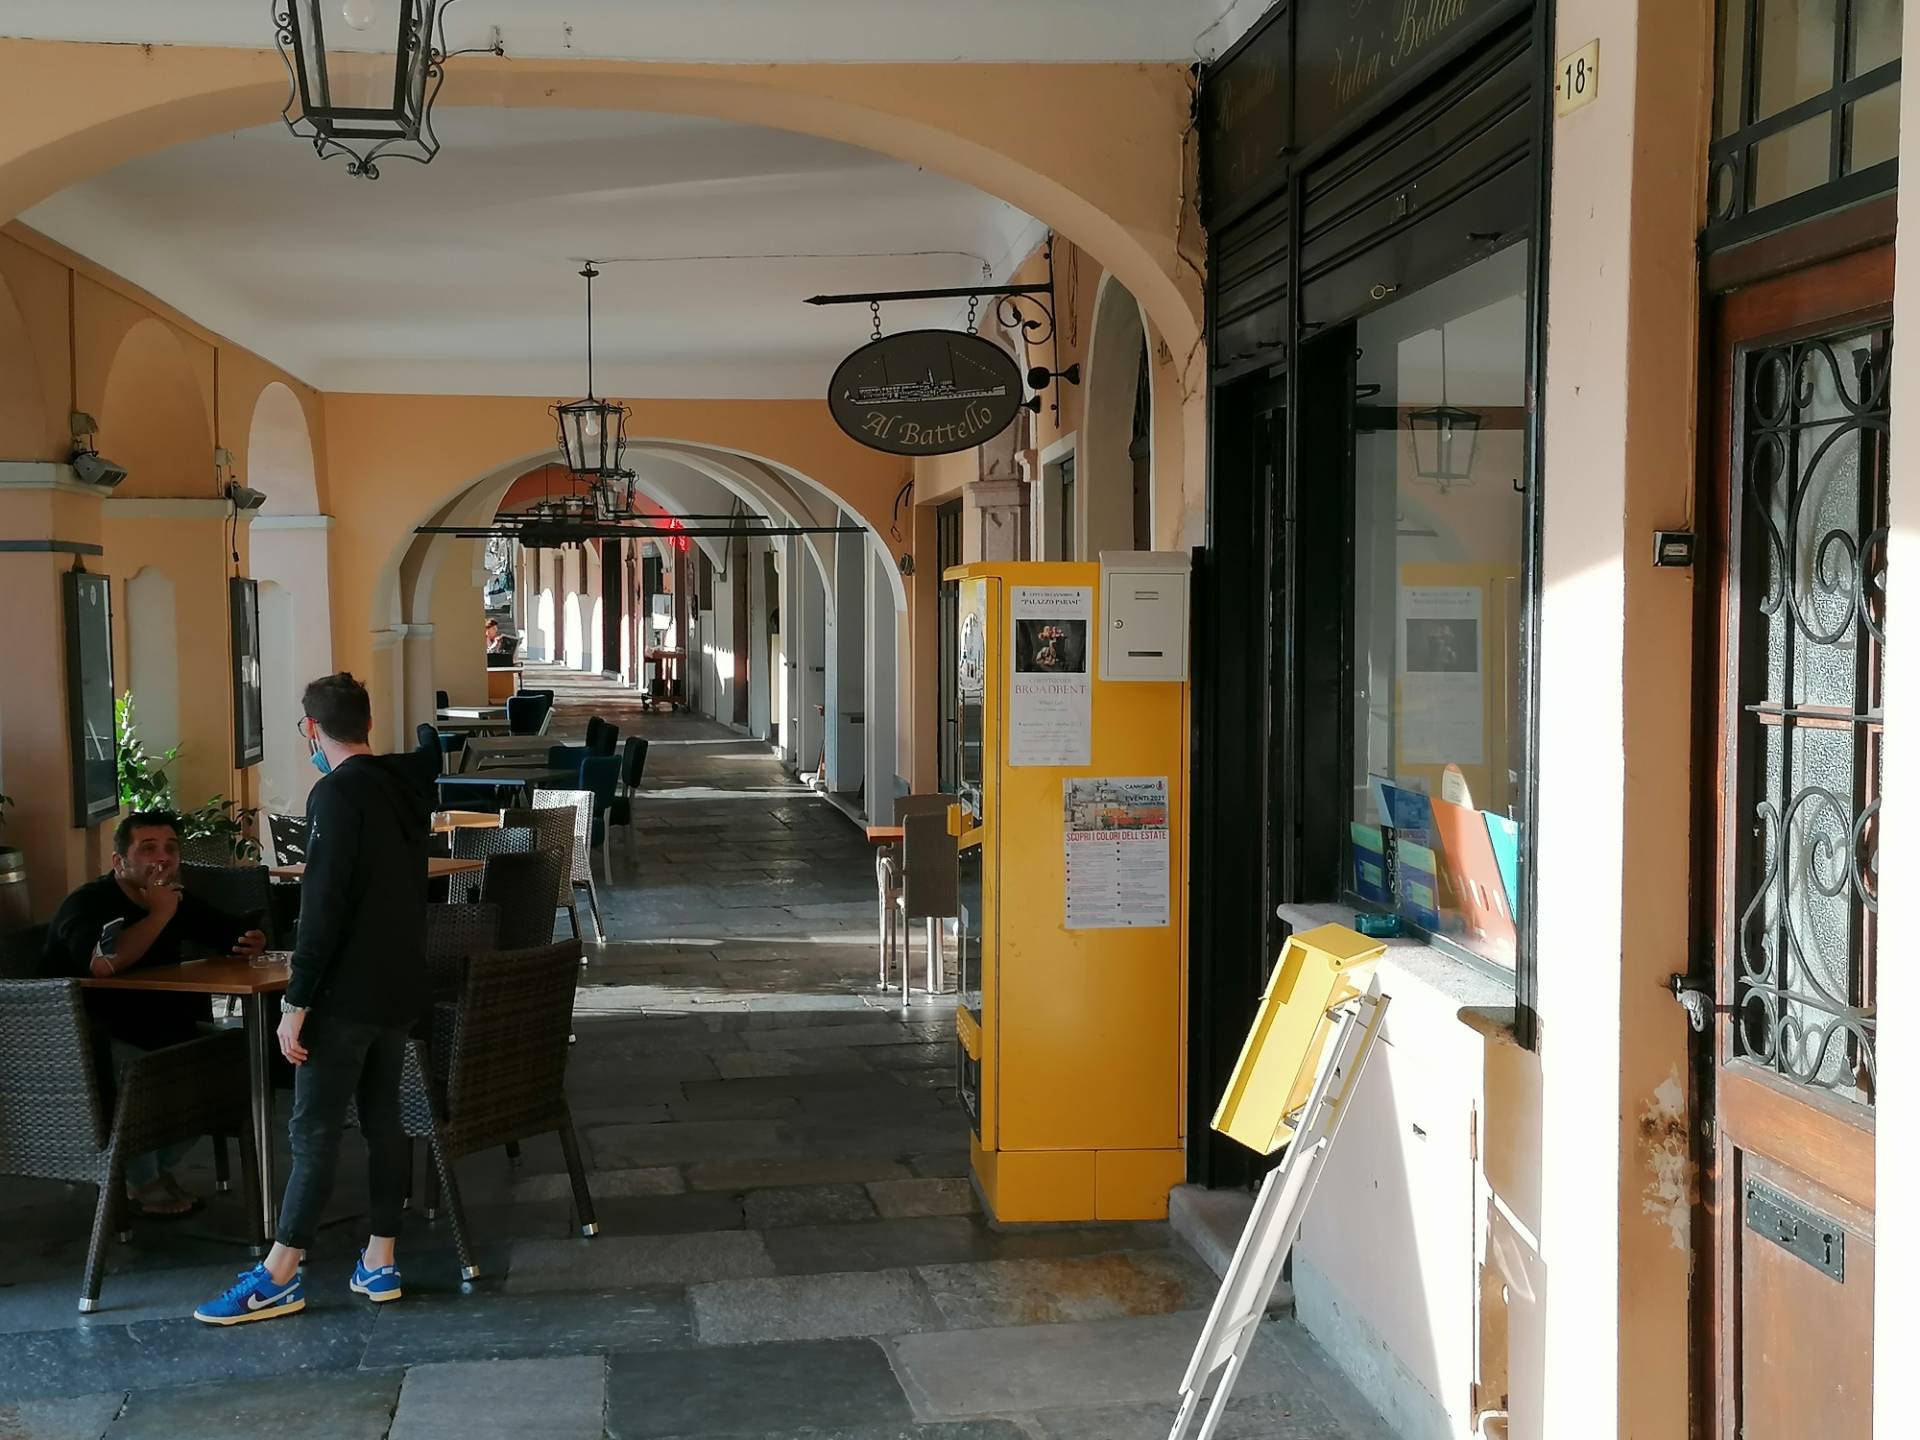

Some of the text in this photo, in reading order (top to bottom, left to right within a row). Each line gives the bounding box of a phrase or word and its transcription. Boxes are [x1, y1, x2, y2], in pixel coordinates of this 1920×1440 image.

[1565, 57, 1585, 100] 18
[862, 400, 993, 445] Al Battello
[1015, 684, 1087, 694] BROADBENT
[1066, 832, 1091, 842] SCOPRI
[1096, 831, 1120, 841] COLORI
